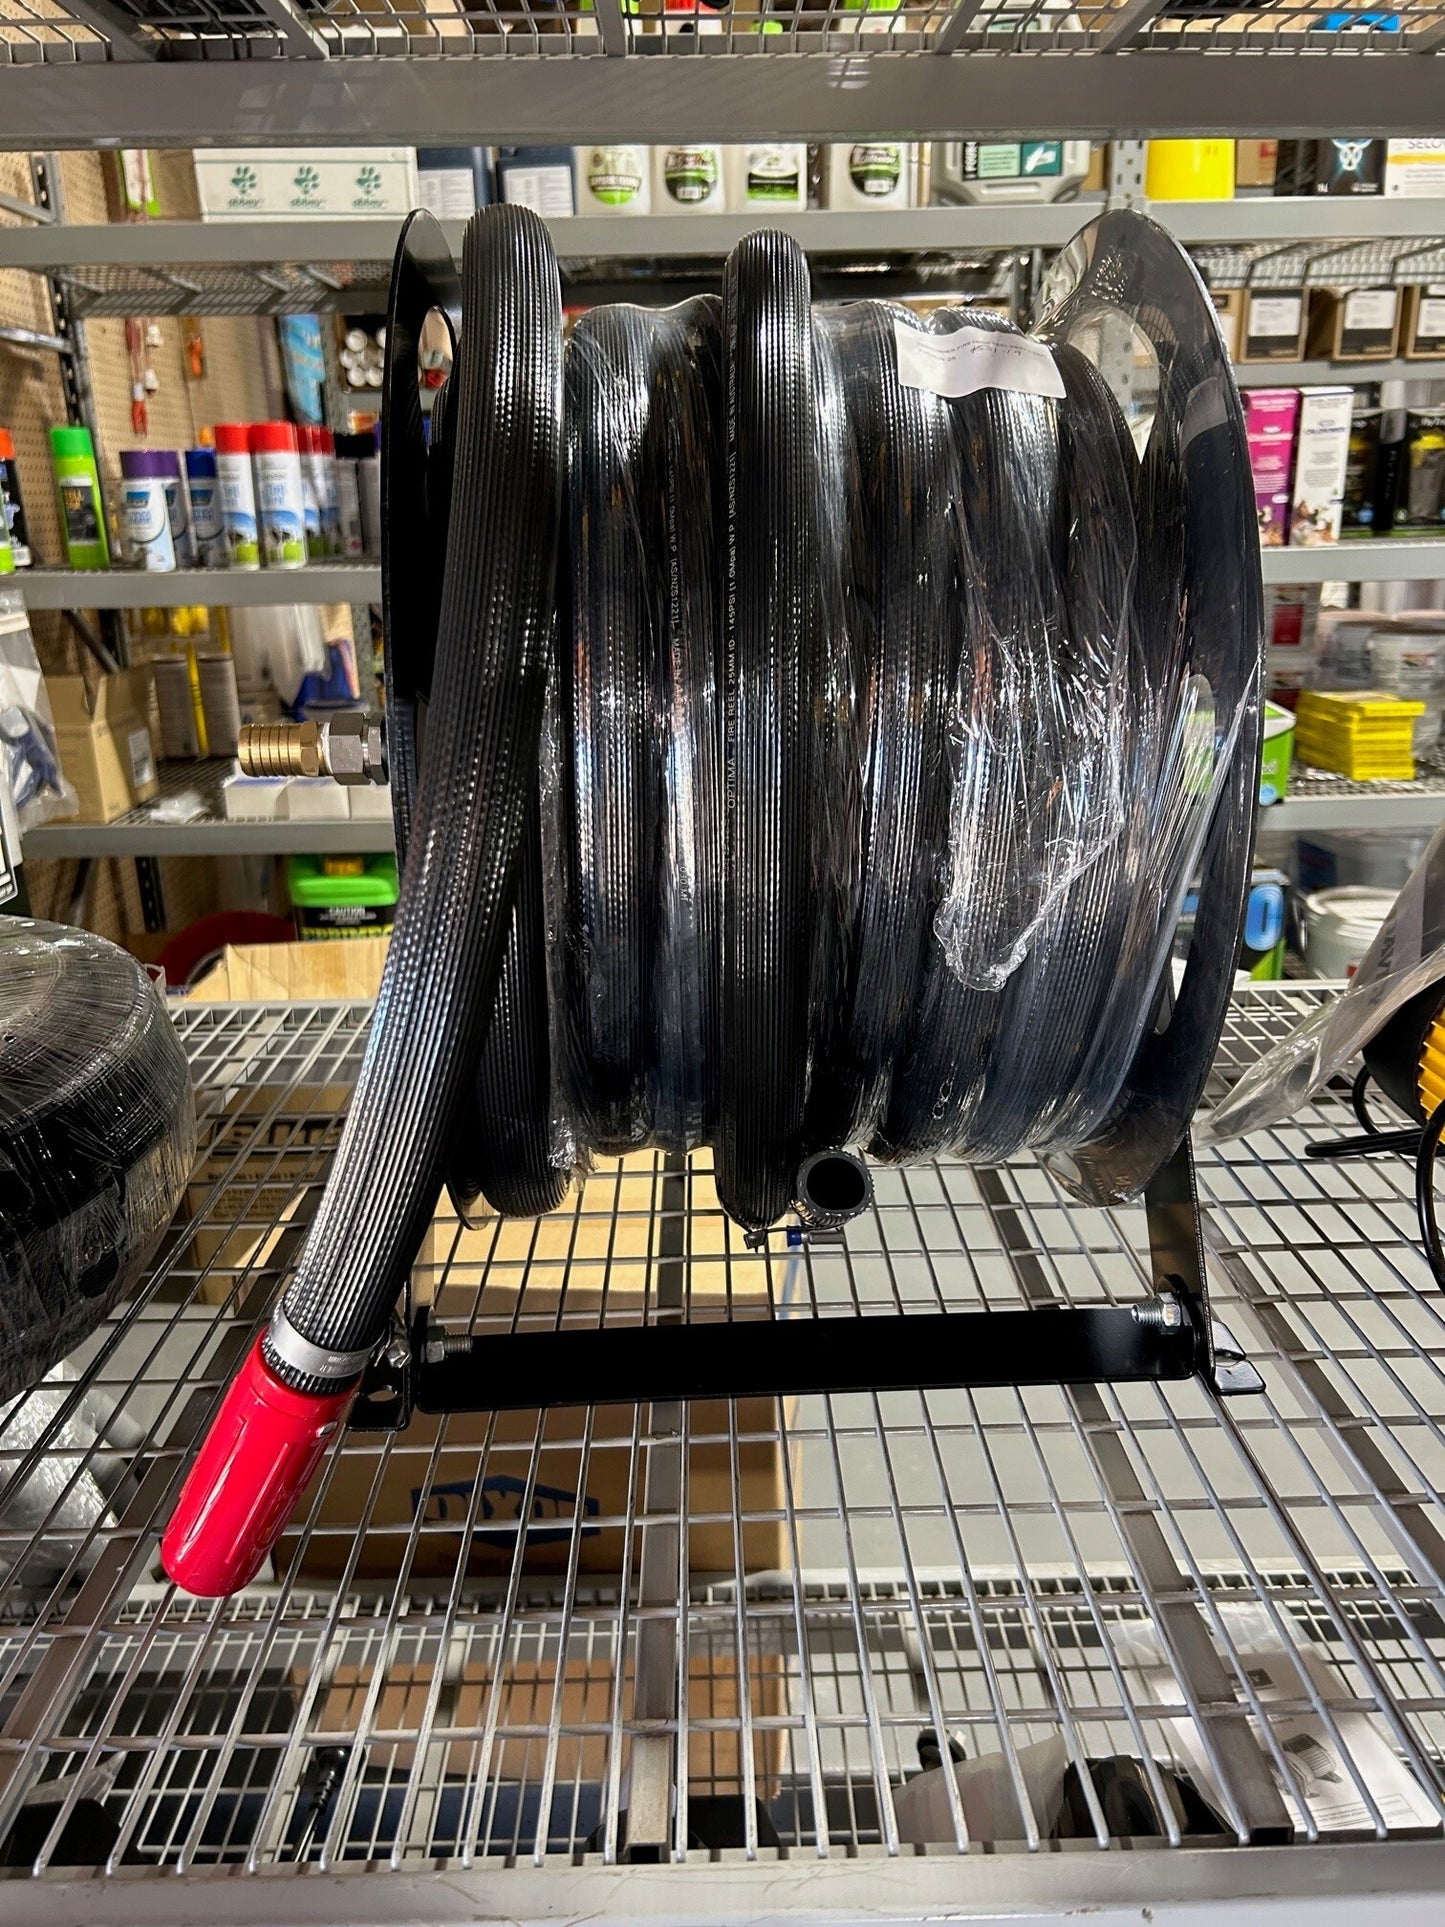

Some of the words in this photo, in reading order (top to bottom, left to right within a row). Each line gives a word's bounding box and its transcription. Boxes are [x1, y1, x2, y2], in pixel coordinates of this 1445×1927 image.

[728, 360, 736, 404] AUSTRALIA
[728, 404, 736, 415] IN
[728, 415, 736, 443] MADE
[727, 451, 737, 518] (AS/NZS1221)
[728, 593, 736, 631] 145PSI
[672, 638, 681, 666] MADE
[728, 653, 736, 684] 25MM
[728, 688, 736, 716] REEL
[727, 720, 736, 743] FIRE
[727, 757, 736, 809] OPTIMA
